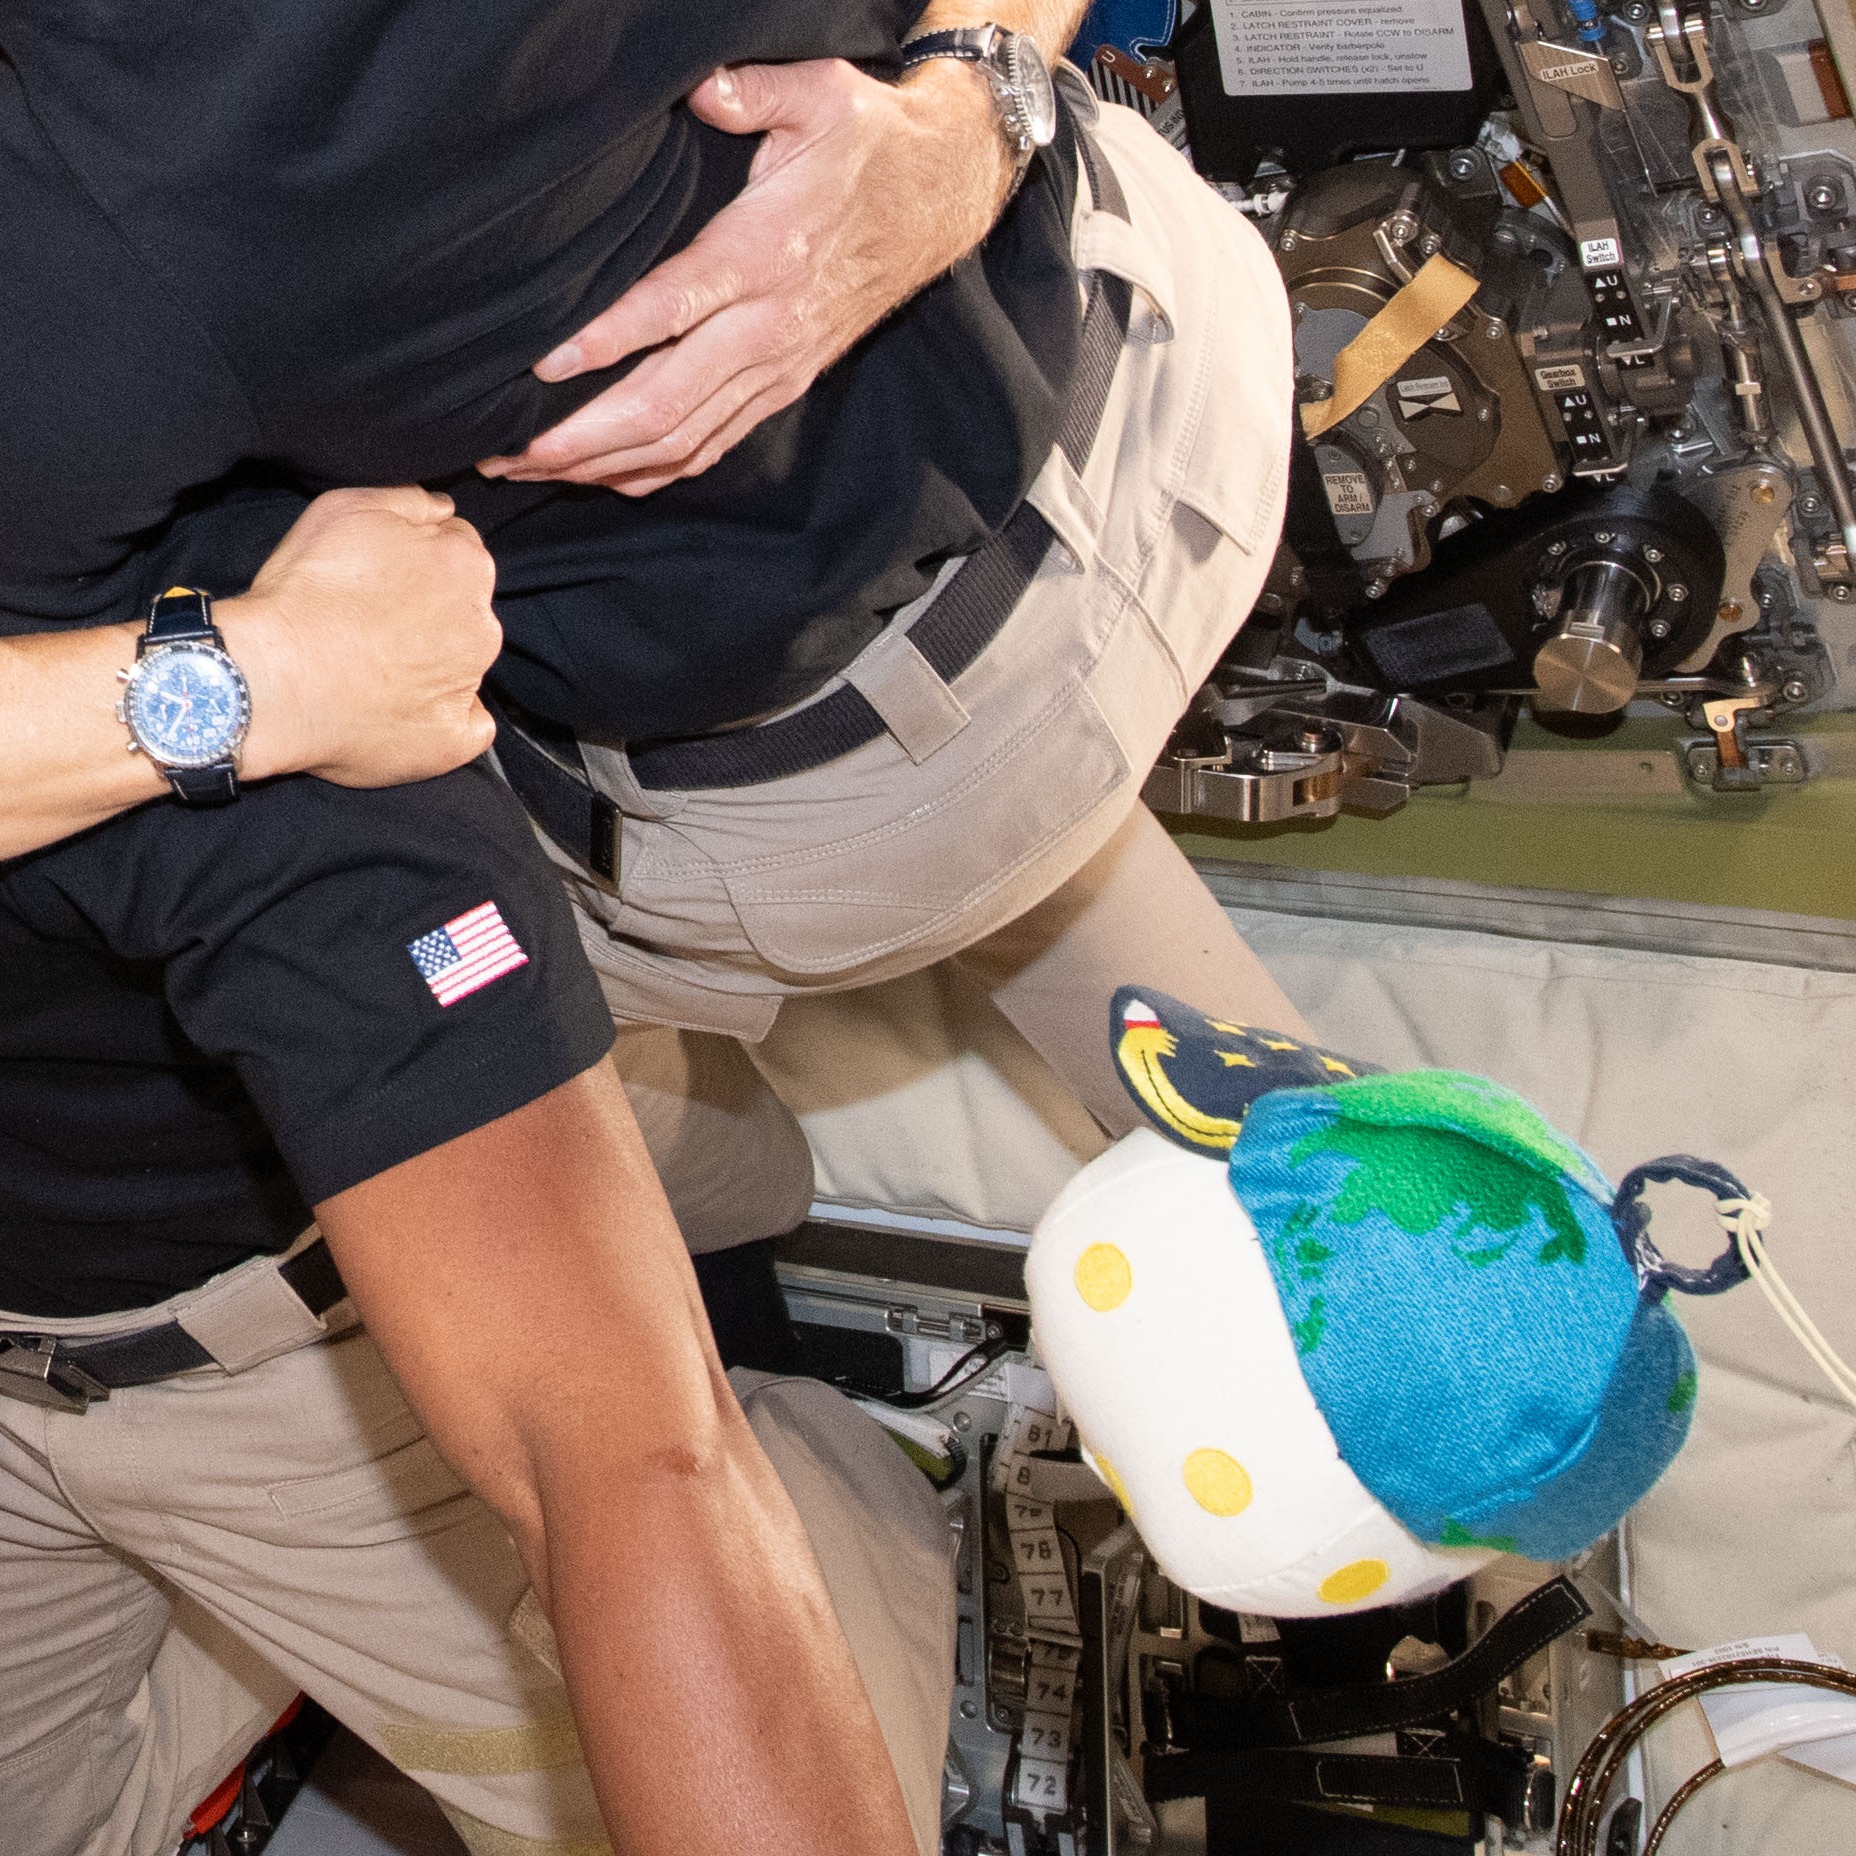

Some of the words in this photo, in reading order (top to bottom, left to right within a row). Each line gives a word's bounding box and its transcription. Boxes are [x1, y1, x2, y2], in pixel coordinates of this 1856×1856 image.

[1241, 10, 1271, 19] CABIN
[1279, 9, 1315, 17] Confirm
[1316, 8, 1357, 17] pressure
[1358, 6, 1402, 15] equalized
[1243, 22, 1276, 30] LATCH
[1277, 19, 1333, 29] RESTRAINT
[1336, 18, 1373, 27] COVER
[1244, 33, 1277, 41] LATCH
[1279, 31, 1335, 40] RESTRAINT
[1344, 30, 1374, 38] Rotate
[1375, 29, 1401, 37] CCW
[1414, 28, 1455, 36] DISARM
[1246, 44, 1301, 53] INDICATOR
[1308, 43, 1334, 52] Verify
[1278, 55, 1300, 63] Hold
[1336, 54, 1369, 62] release
[1250, 66, 1304, 76] DIRECTION
[1306, 65, 1359, 75] SWITCHES
[1386, 64, 1403, 72] Set
[1416, 63, 1424, 71] U
[1542, 67, 1568, 80] ILAH
[1570, 63, 1597, 75] Lock
[1282, 79, 1307, 87] Pump
[1353, 77, 1373, 85] until
[1374, 77, 1400, 85] hatch
[1401, 77, 1430, 85] opens
[1587, 242, 1610, 252] ILAH
[1586, 251, 1616, 264] Switch
[1606, 275, 1618, 286] U
[1619, 314, 1632, 326] N
[1540, 368, 1577, 379] Gearbox
[1546, 377, 1577, 389] Switch
[1575, 395, 1587, 406] U
[1589, 433, 1601, 443] N
[1324, 475, 1366, 485] REMOVE
[1340, 485, 1354, 494] TO
[1334, 503, 1371, 513] DISARM
[1020, 1541, 1052, 1560] 78
[1031, 1589, 1064, 1607] 77
[1036, 1681, 1068, 1700] 74
[1030, 1726, 1063, 1748] 73
[1027, 1773, 1057, 1795] 72
